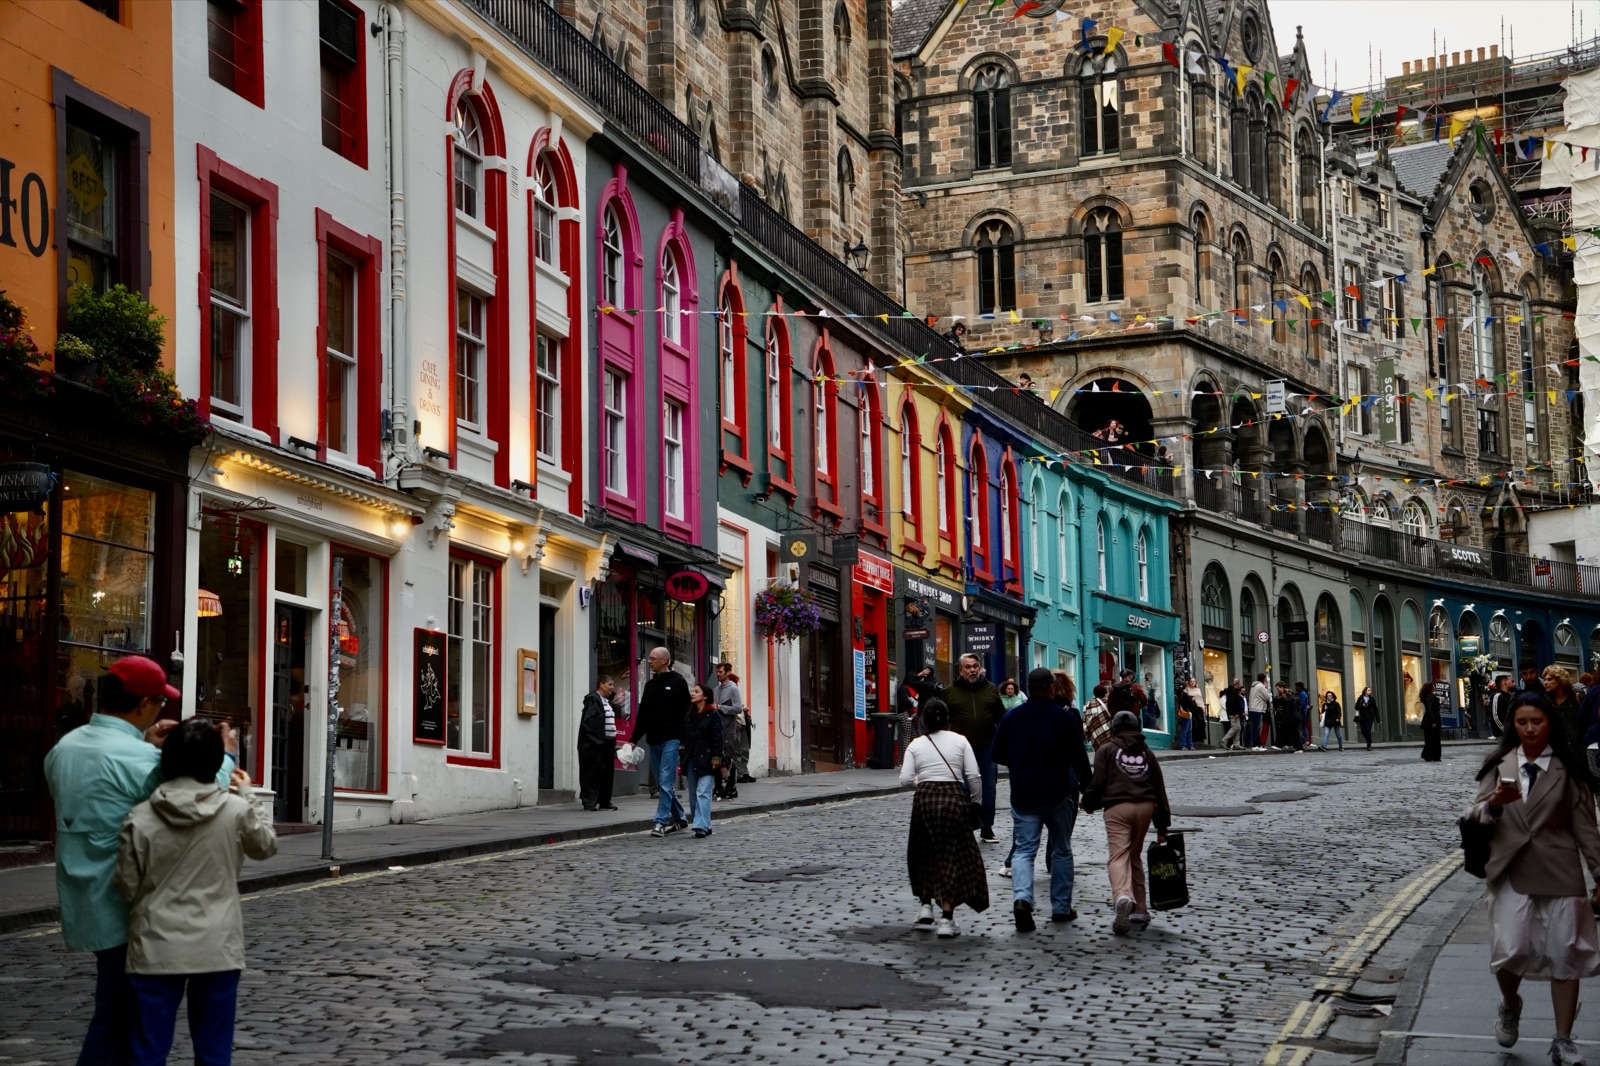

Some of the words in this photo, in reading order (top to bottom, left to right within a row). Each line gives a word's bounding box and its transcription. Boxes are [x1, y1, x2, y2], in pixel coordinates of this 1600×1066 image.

[72, 169, 97, 194] BEST
[1384, 376, 1394, 424] SCOTTS
[1452, 548, 1481, 564] SCOTTS
[908, 578, 918, 592] THE
[918, 580, 938, 600] WHISKY
[939, 590, 952, 605] SHOP
[1128, 614, 1152, 630] SWISH
[968, 634, 995, 643] WHISKY
